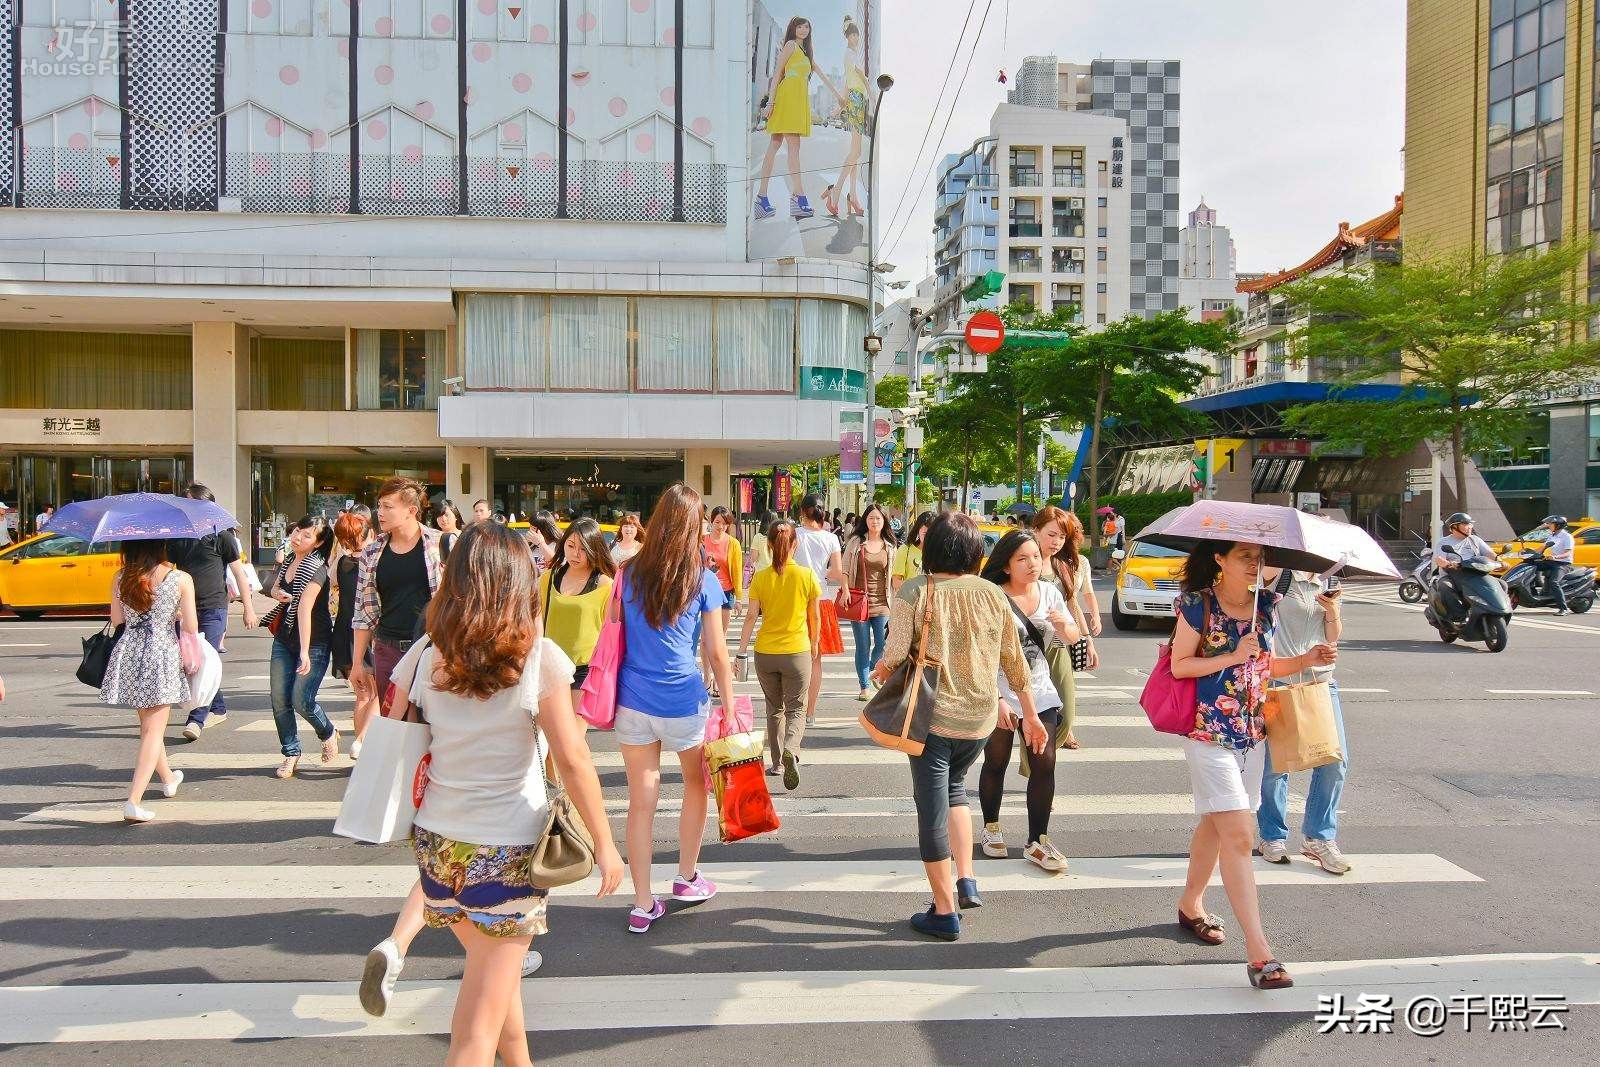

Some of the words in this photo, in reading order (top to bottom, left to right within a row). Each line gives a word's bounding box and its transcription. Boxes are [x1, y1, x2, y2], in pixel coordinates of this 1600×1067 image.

[1112, 136, 1123, 188] 廣朋建設
[43, 417, 100, 431] 新光三越
[1224, 448, 1235, 473] 1
